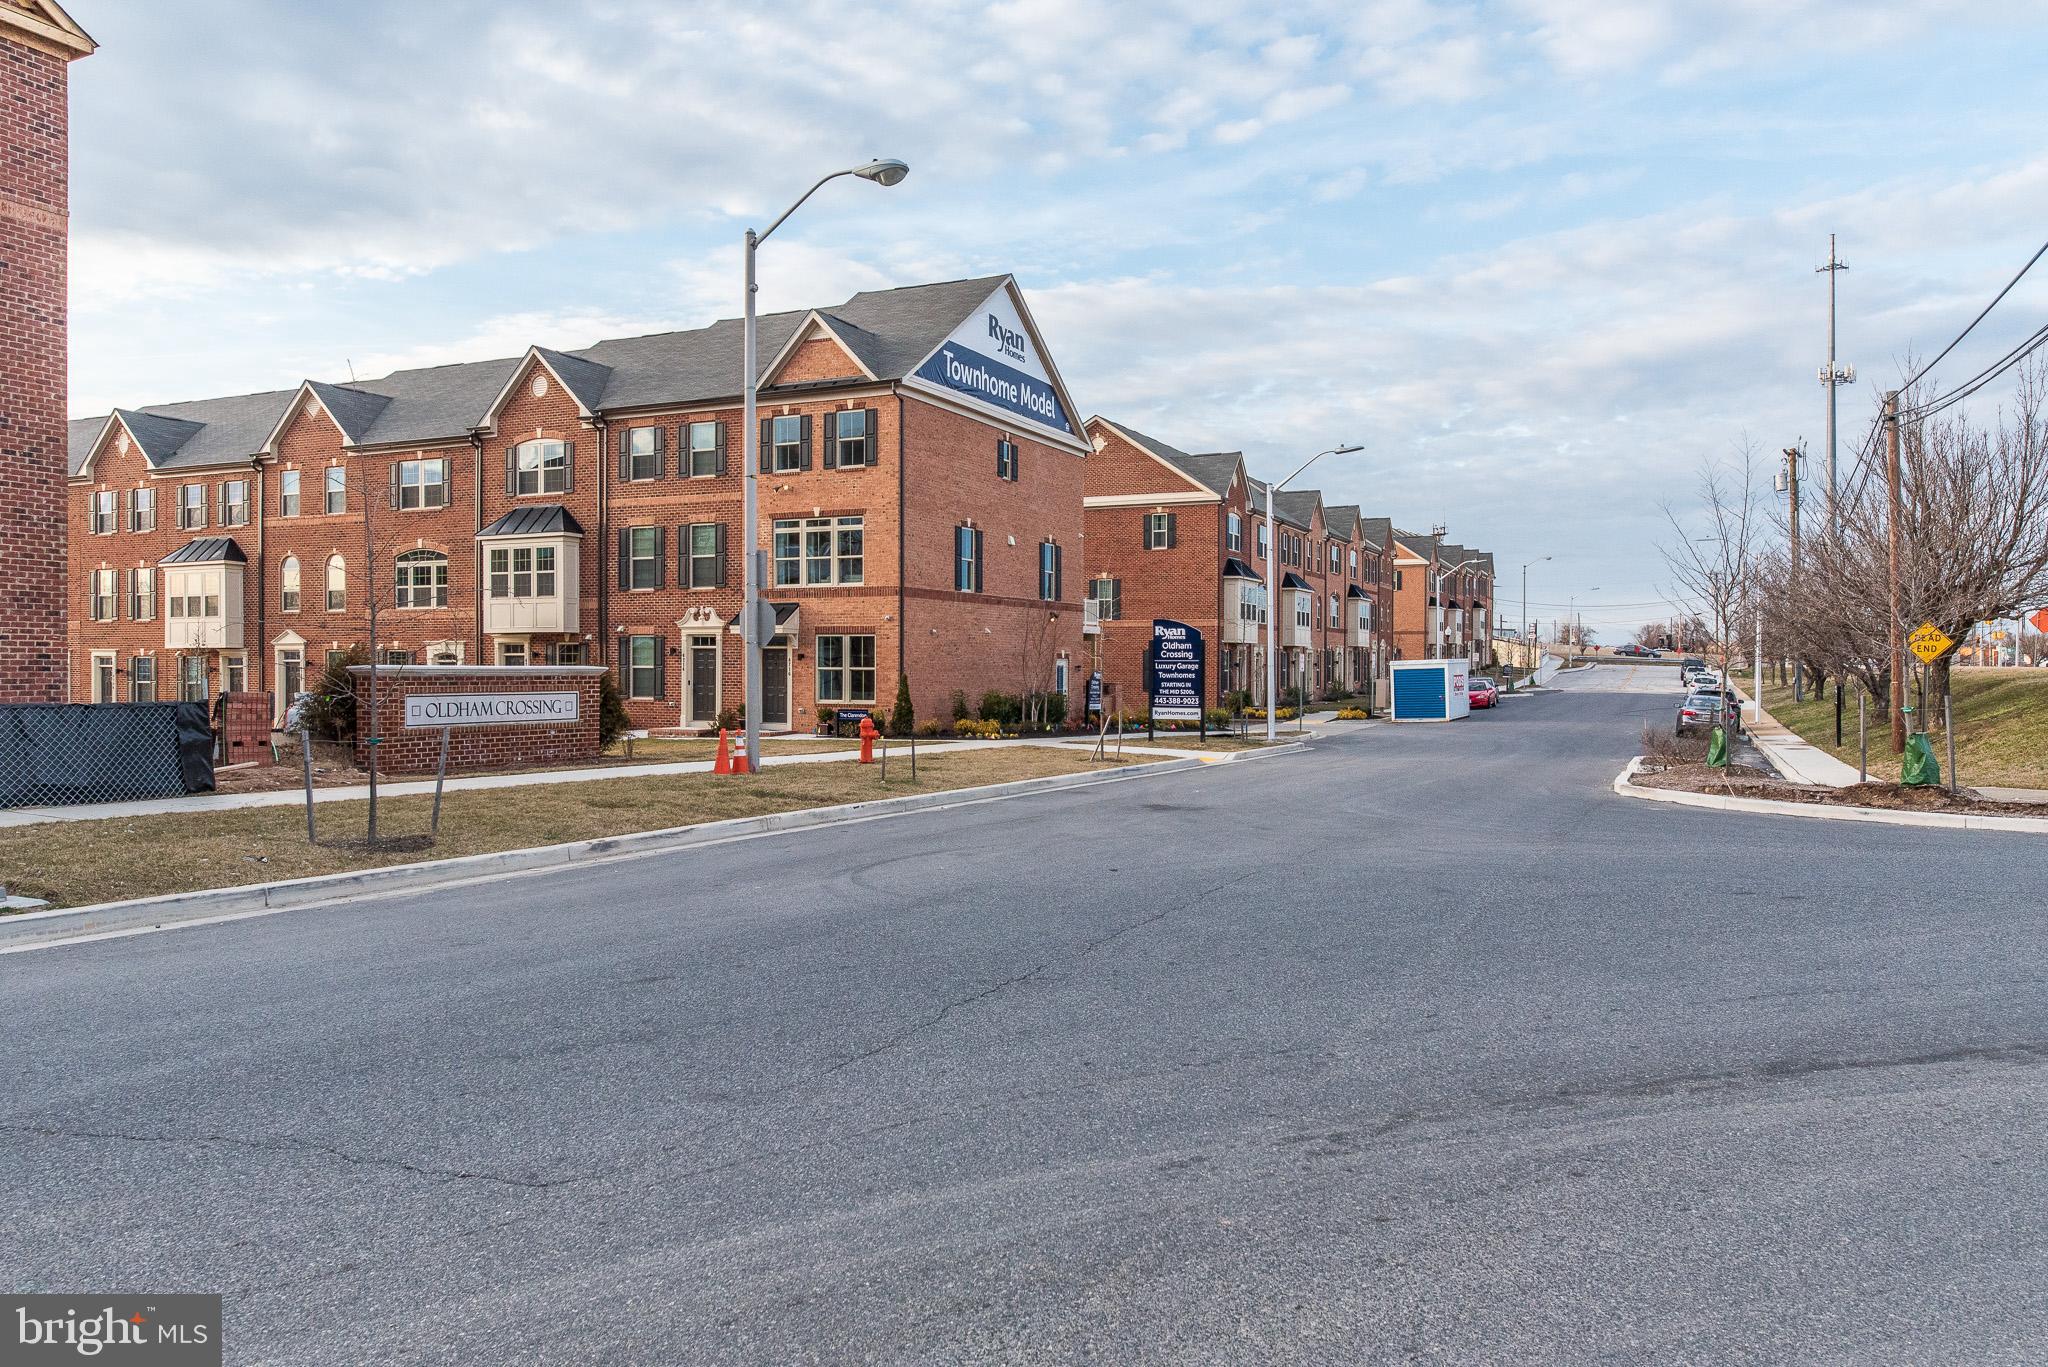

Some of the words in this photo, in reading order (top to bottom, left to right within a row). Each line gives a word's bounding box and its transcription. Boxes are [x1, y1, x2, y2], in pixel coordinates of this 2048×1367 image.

[988, 313, 1024, 352] Ryan
[1004, 345, 1026, 364] Homes
[943, 349, 1017, 404] Townhome
[1020, 382, 1056, 419] Model
[1154, 625, 1186, 640] Ryan
[1162, 641, 1192, 650] Oldham
[1917, 645, 1937, 653] END
[1160, 650, 1193, 660] Crossing
[1155, 663, 1176, 671] Luxury
[1177, 663, 1199, 671] Garage
[1154, 697, 1199, 705] 443-388-9023
[425, 702, 494, 719] OLDHAM
[495, 700, 562, 716] CROSSING
